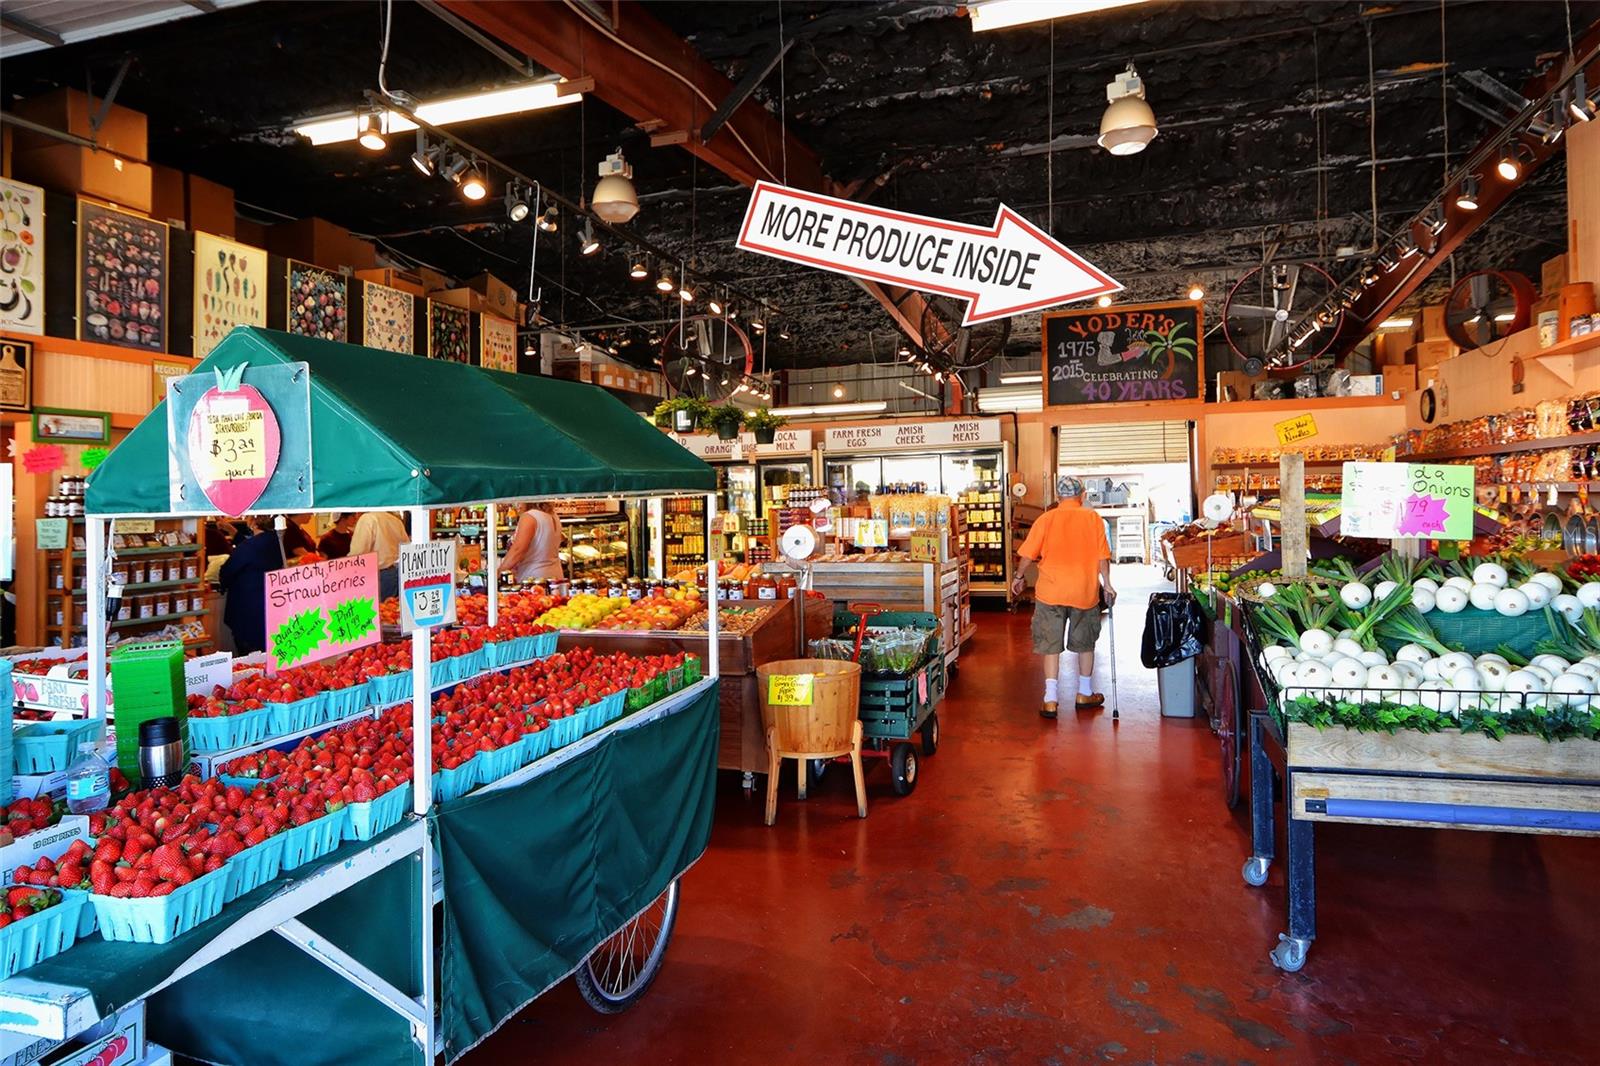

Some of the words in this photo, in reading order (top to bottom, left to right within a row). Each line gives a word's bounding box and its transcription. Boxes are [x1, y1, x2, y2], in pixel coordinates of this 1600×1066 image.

[760, 201, 834, 249] MORE
[832, 217, 953, 275] PRODUCE
[952, 240, 1042, 291] INSIDE
[1068, 313, 1175, 338] YODER'S
[1057, 341, 1096, 358] 1975
[1052, 363, 1084, 381] 2015
[1083, 370, 1158, 382] CELEBRATING
[1081, 382, 1111, 400] 40
[1118, 379, 1187, 400] YEARS
[832, 430, 854, 439] FARM
[857, 428, 881, 438] FRESH
[897, 425, 923, 435] AMISH
[953, 422, 979, 432] AMISH
[775, 432, 797, 441] OCAL
[847, 438, 867, 448] EGGS
[895, 434, 925, 445] CHEESE
[952, 431, 979, 441] MEATS
[705, 444, 732, 454] ORANG
[776, 442, 796, 451] MILK
[225, 464, 254, 482] quart
[1412, 480, 1470, 498] Onions
[402, 550, 427, 574] PLANT
[430, 545, 450, 568] CITY
[268, 567, 300, 587] Plant
[328, 556, 366, 571] Florida
[270, 575, 365, 608] Strawberries
[335, 603, 355, 622] Pint
[275, 614, 301, 646] Quart
[41, 678, 68, 695] FARM
[48, 693, 77, 708] FRESH
[42, 834, 59, 847] DRY
